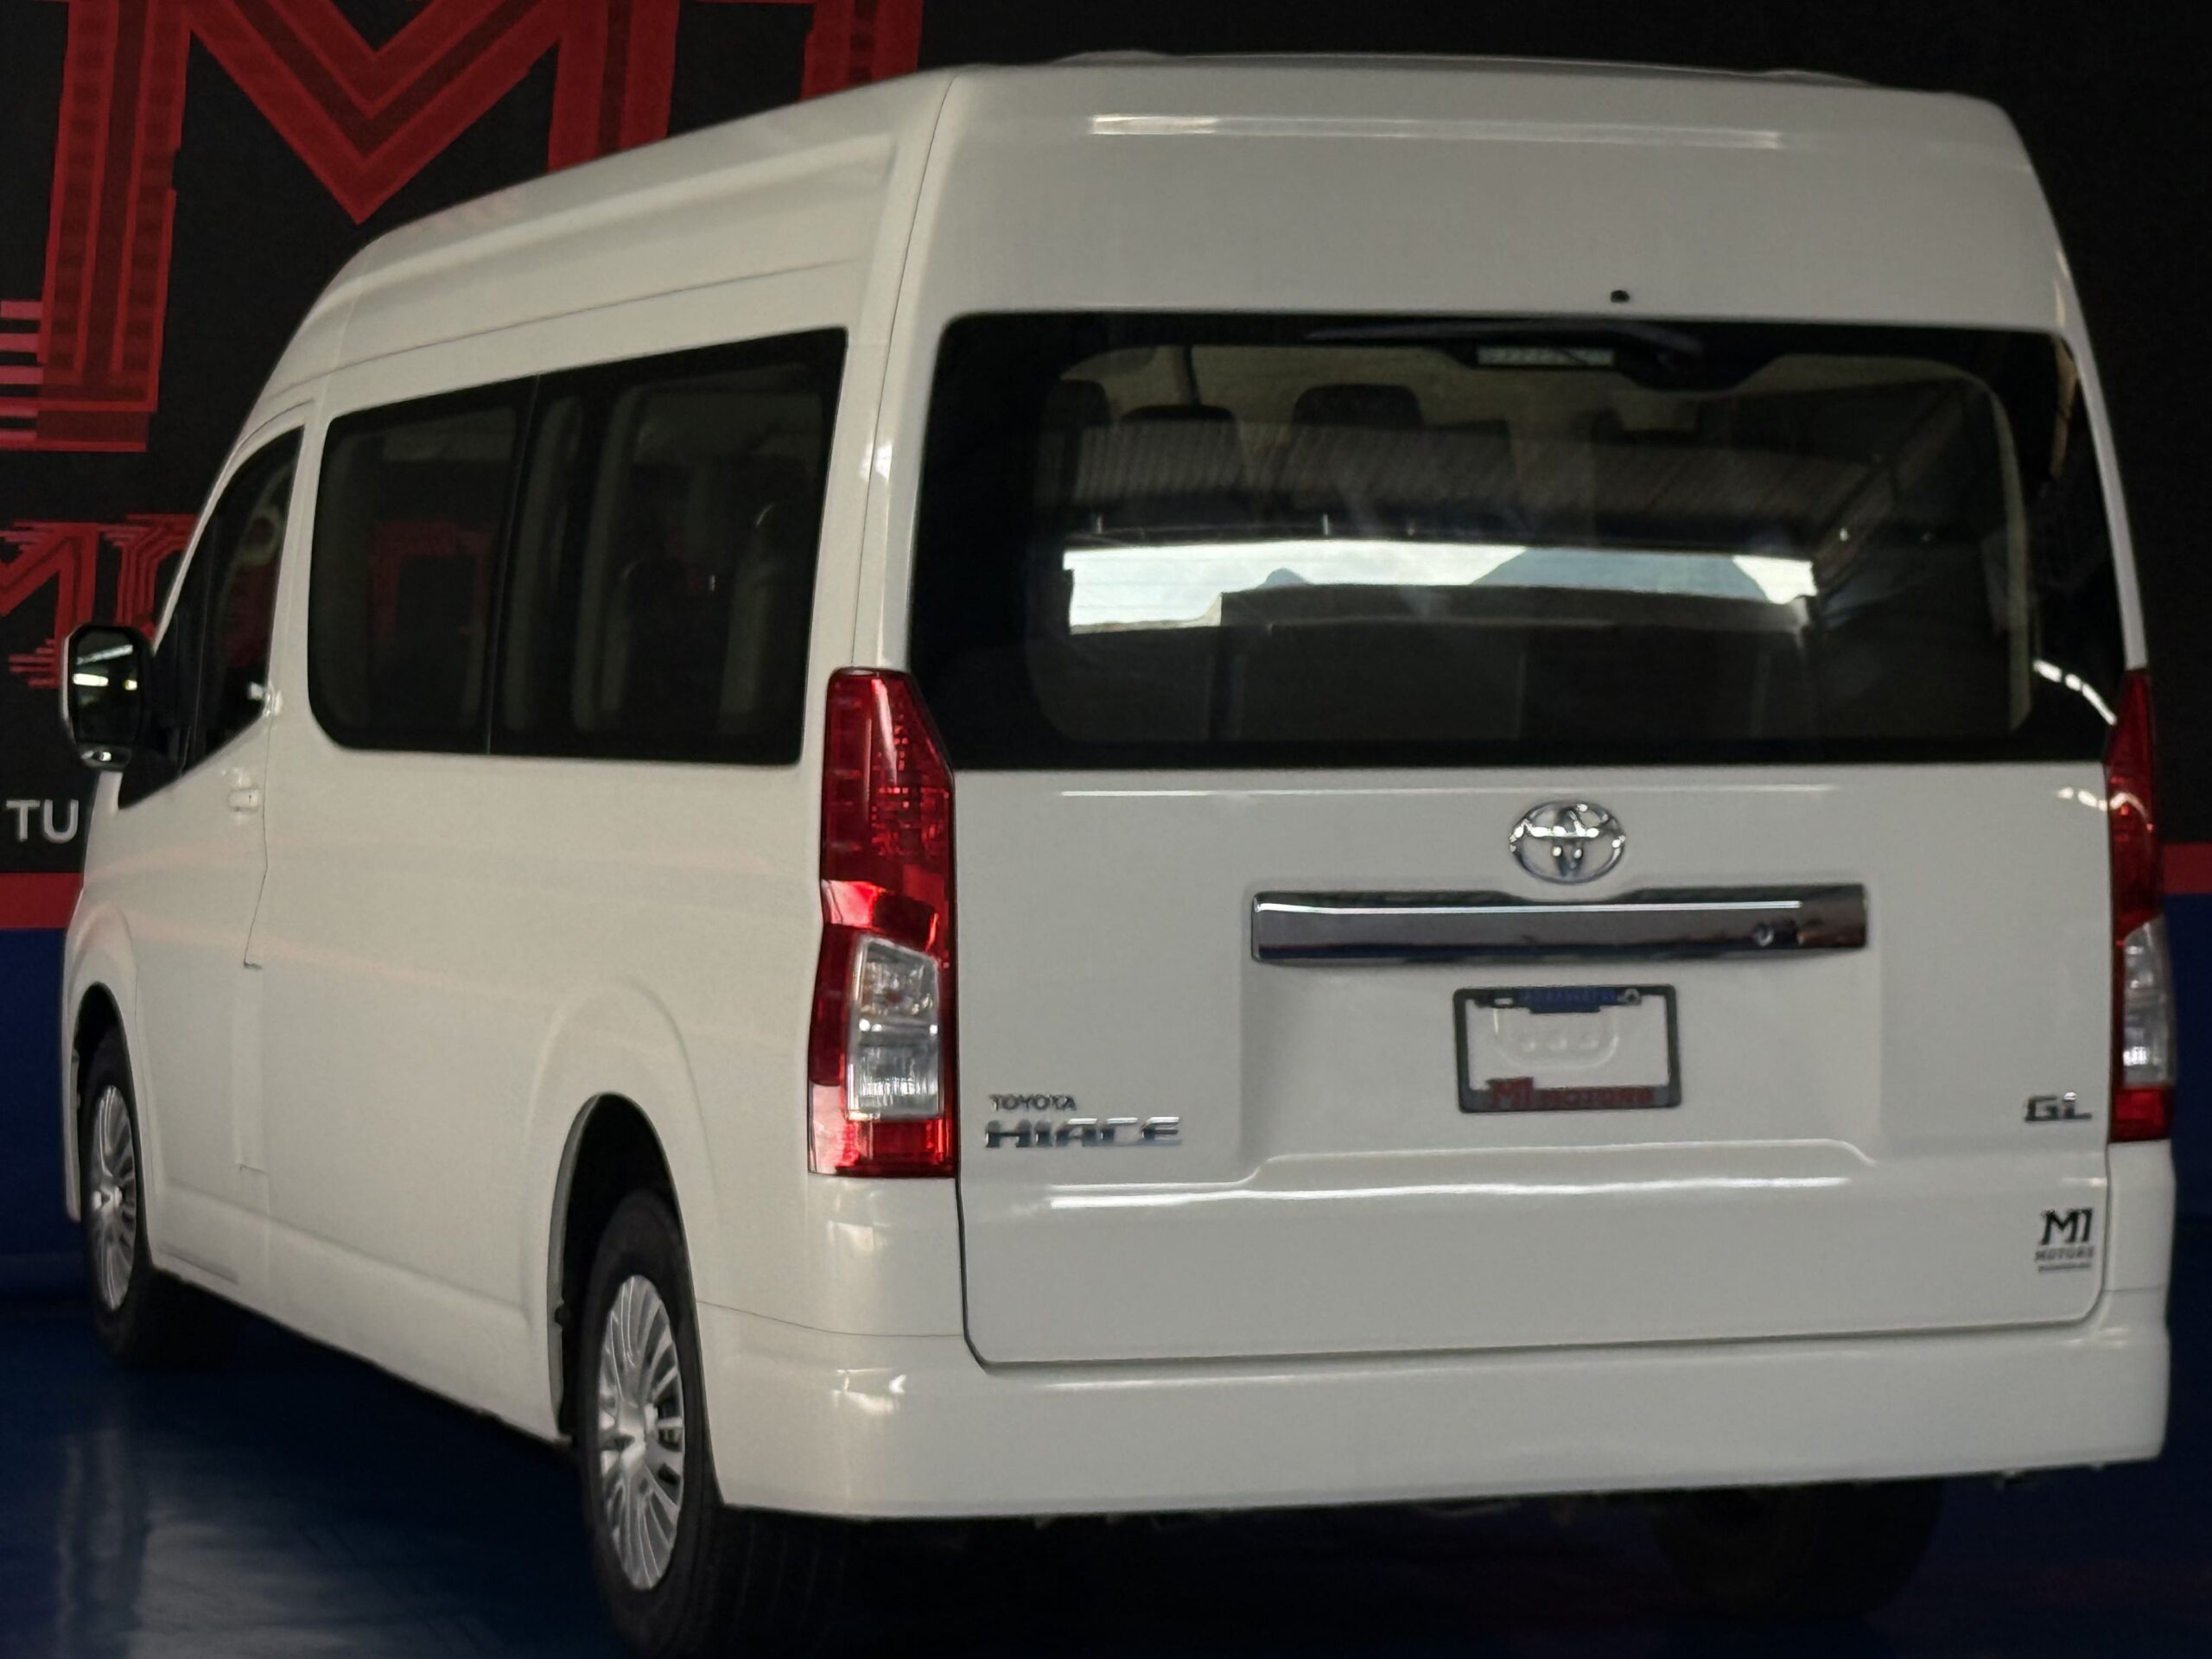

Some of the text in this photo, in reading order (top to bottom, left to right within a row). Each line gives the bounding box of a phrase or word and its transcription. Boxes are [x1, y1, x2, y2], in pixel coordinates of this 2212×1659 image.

[6, 799, 79, 842] TU
[988, 1094, 1077, 1110] TOYOTA
[2025, 1092, 2093, 1122] GL
[985, 1116, 1181, 1147] HIACE
